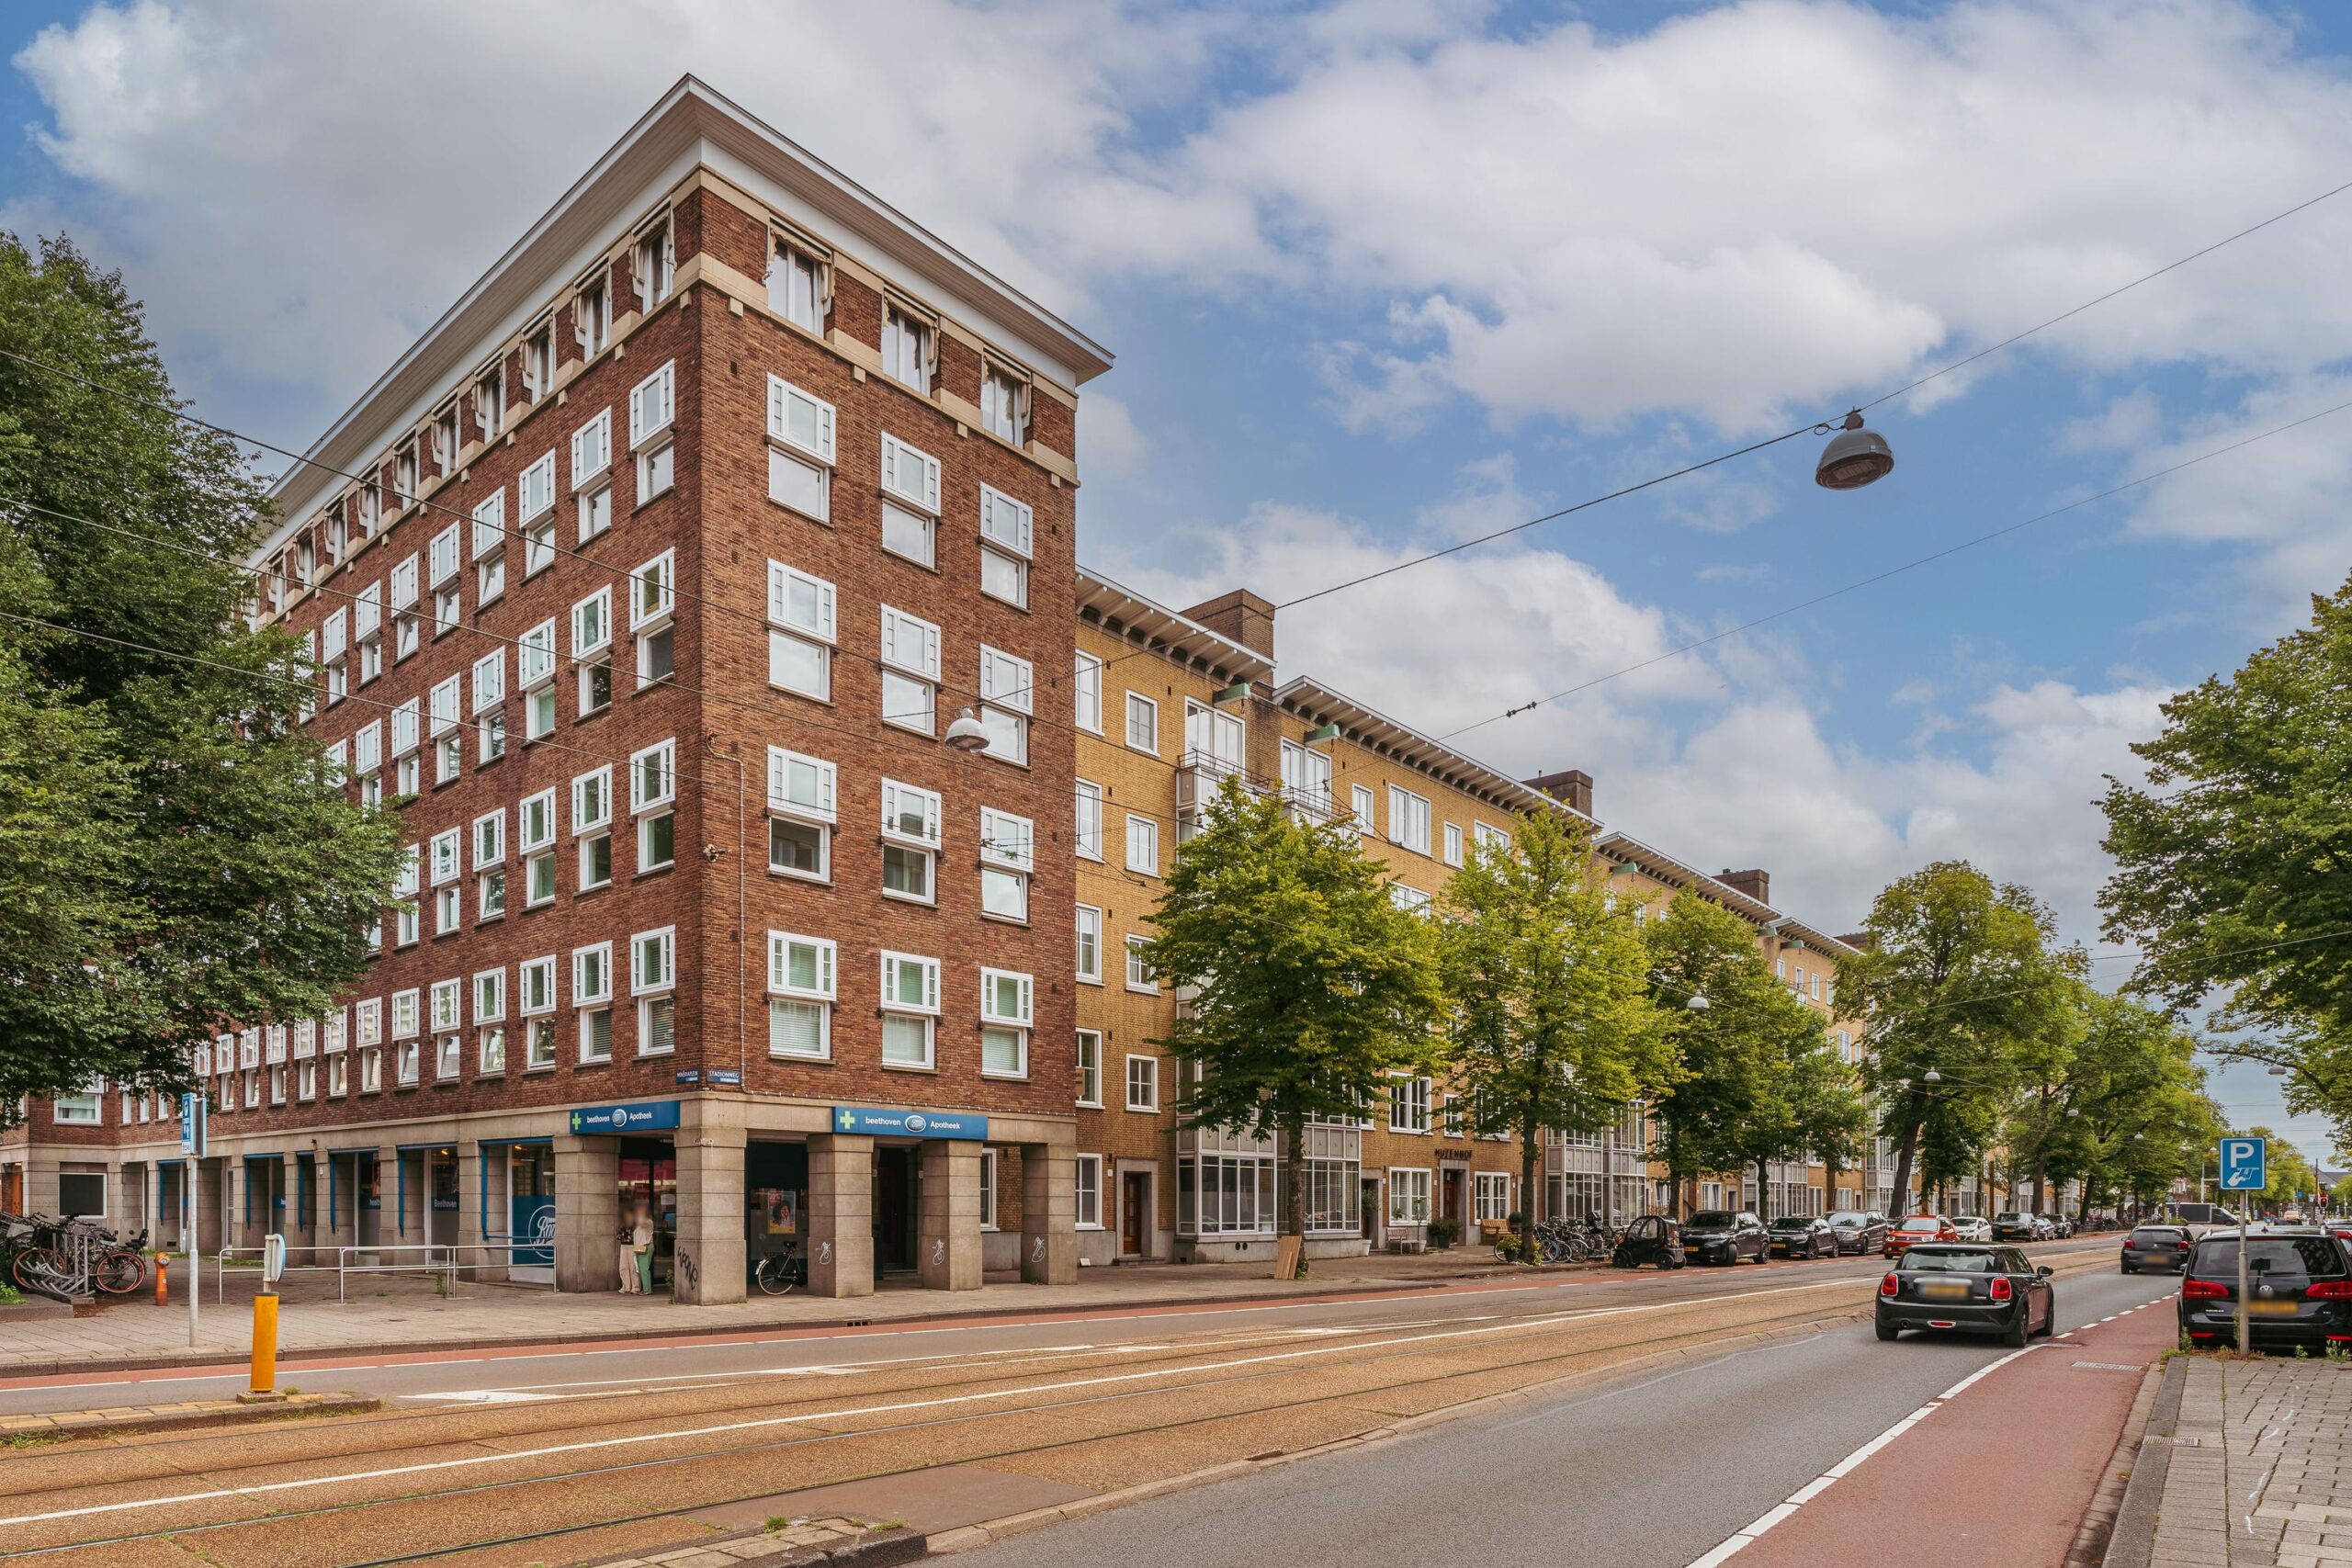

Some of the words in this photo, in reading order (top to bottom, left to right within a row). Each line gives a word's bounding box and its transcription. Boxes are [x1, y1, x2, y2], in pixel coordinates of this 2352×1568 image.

[709, 1070, 740, 1079] STADIONWEG
[587, 1115, 610, 1124] beethoven
[629, 1111, 652, 1121] Apotheek
[865, 1116, 901, 1126] beethoven
[930, 1121, 961, 1131] Apotheek
[2230, 1142, 2255, 1168] P
